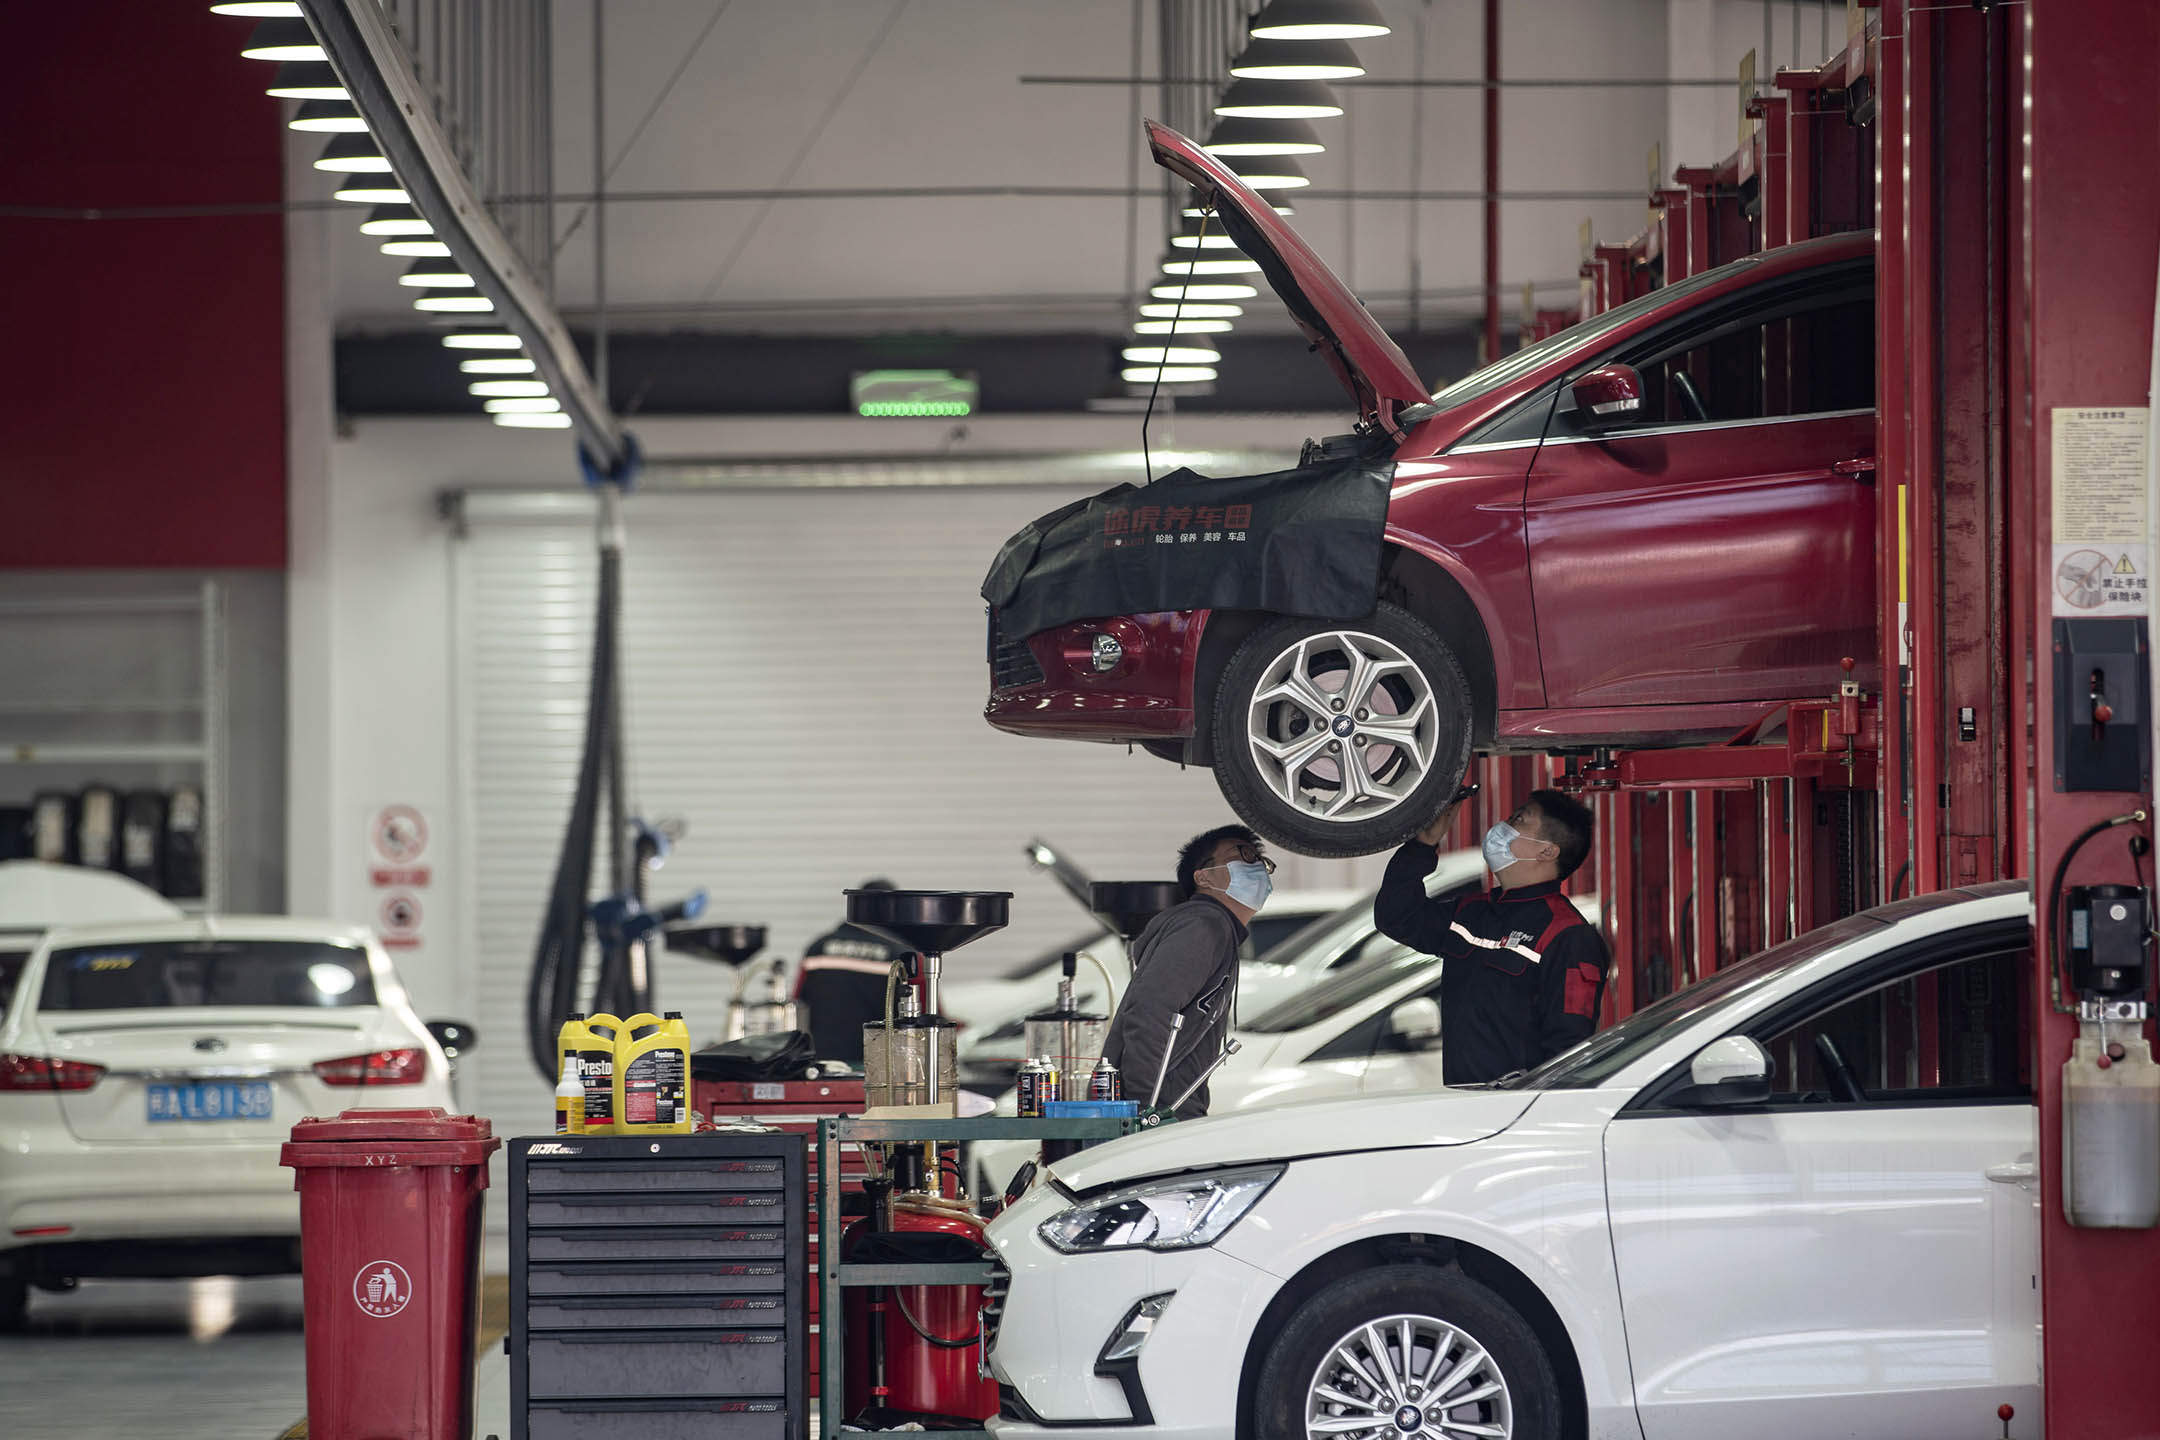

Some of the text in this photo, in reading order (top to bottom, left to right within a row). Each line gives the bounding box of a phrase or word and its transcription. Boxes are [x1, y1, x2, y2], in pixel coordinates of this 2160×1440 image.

[1155, 533, 1174, 544] 轮胎
[1179, 532, 1197, 543] 保养
[1203, 531, 1222, 542] 美容
[1227, 531, 1246, 541] 车品
